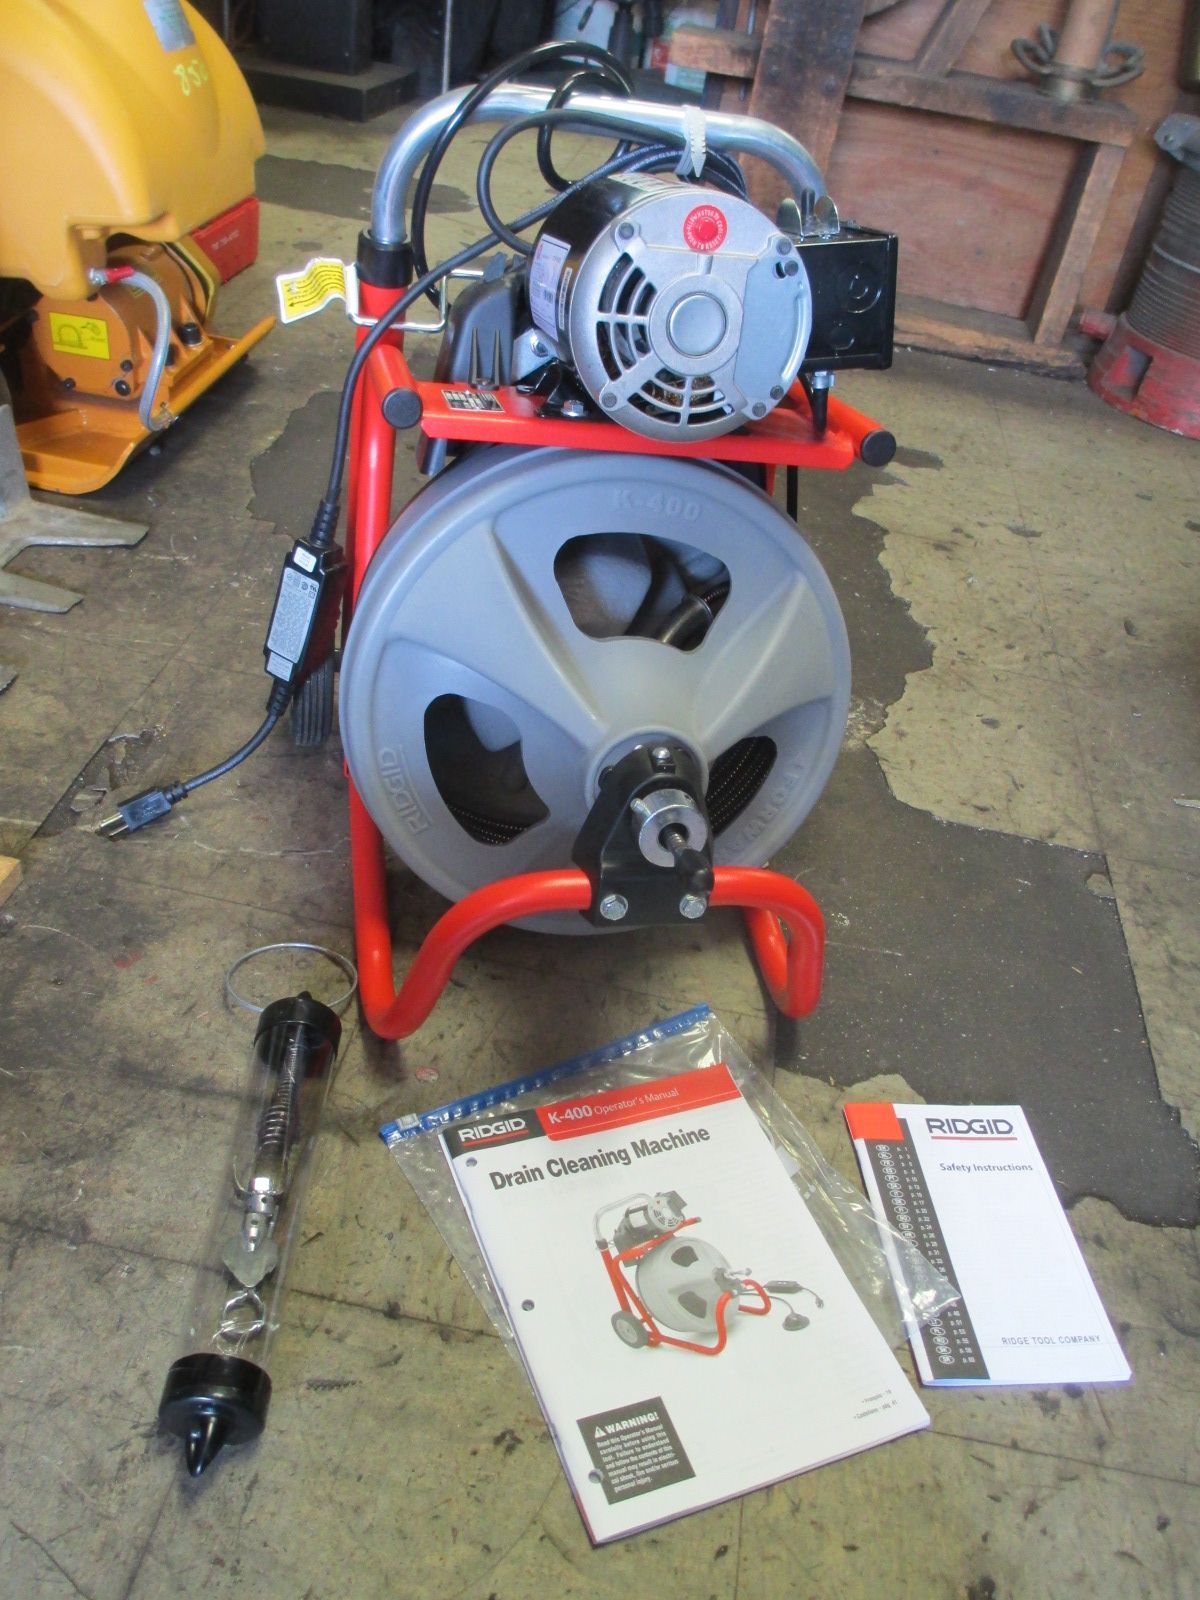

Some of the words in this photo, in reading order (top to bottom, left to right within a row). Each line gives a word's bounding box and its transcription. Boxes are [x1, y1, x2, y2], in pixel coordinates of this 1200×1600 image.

[612, 488, 704, 521] K-400
[378, 747, 429, 834] RIDGID
[458, 1117, 526, 1143] RIDGID
[548, 1104, 593, 1124] K-400
[594, 1096, 644, 1116] Operator's
[644, 1088, 679, 1104] Manual
[925, 1118, 1014, 1134] RIDGID
[489, 1164, 544, 1190] Drain
[546, 1148, 632, 1179] Cleaning
[630, 1126, 711, 1159] Machine
[940, 1163, 971, 1173] Safety
[973, 1164, 1033, 1172] Instructions
[1001, 1336, 1030, 1345] RIDGE
[1032, 1336, 1056, 1345] TOOL
[1058, 1335, 1100, 1344] COMPANY
[604, 1411, 660, 1434] WARNING!
